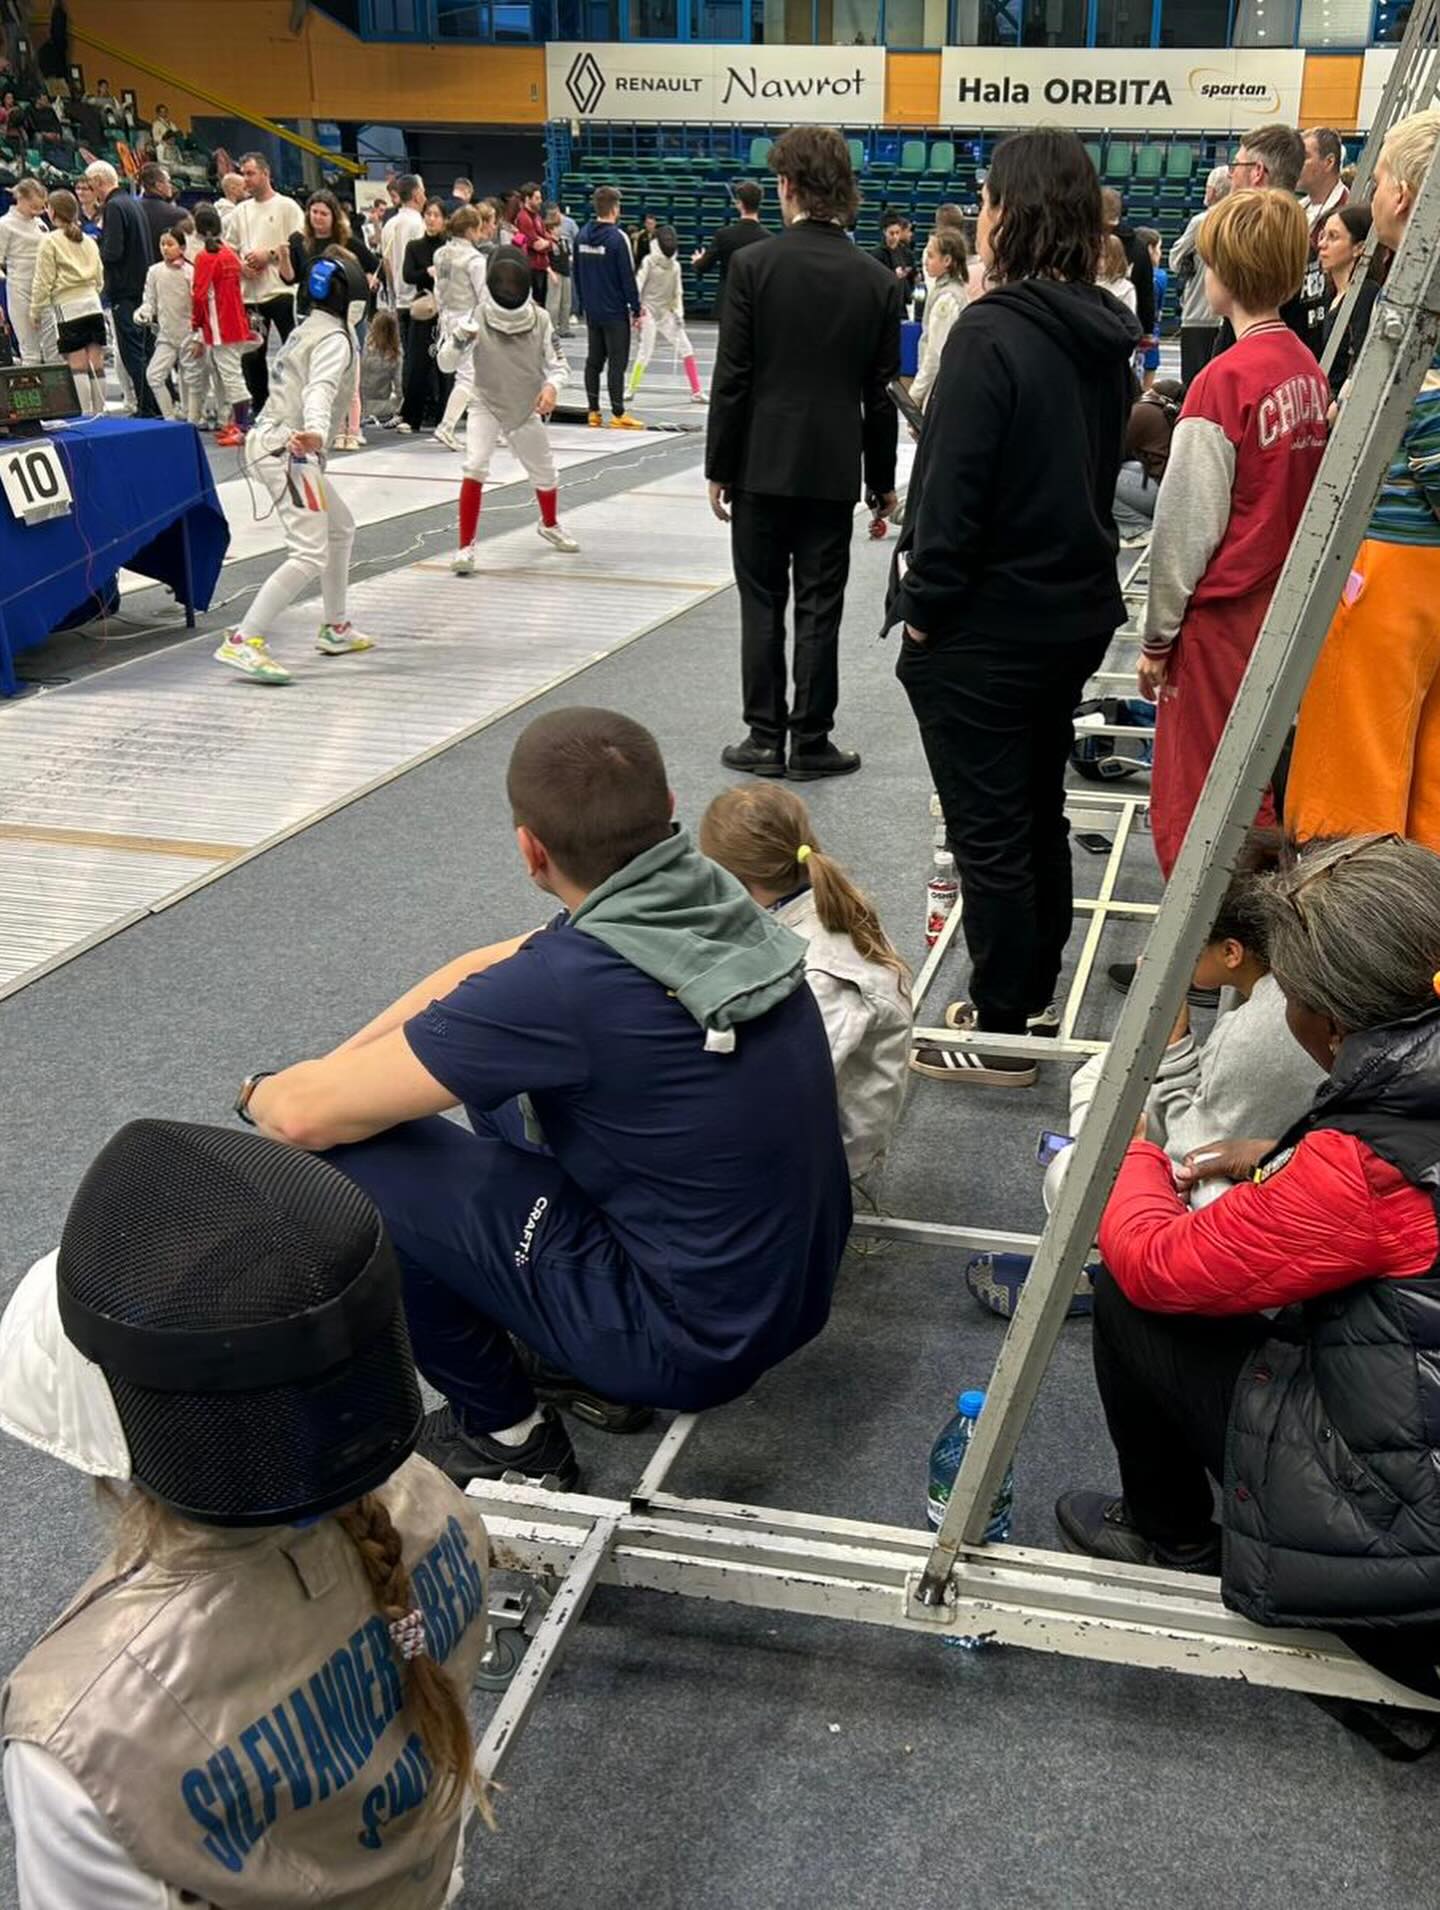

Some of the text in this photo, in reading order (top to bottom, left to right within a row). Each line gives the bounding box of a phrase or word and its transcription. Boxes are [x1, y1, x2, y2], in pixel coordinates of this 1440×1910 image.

[615, 66, 865, 104] RENAULT Nawrot
[958, 76, 1173, 106] Hala ORBITA
[1200, 83, 1267, 98] spartan
[8, 451, 60, 504] 10
[519, 1196, 549, 1254] CRAFT
